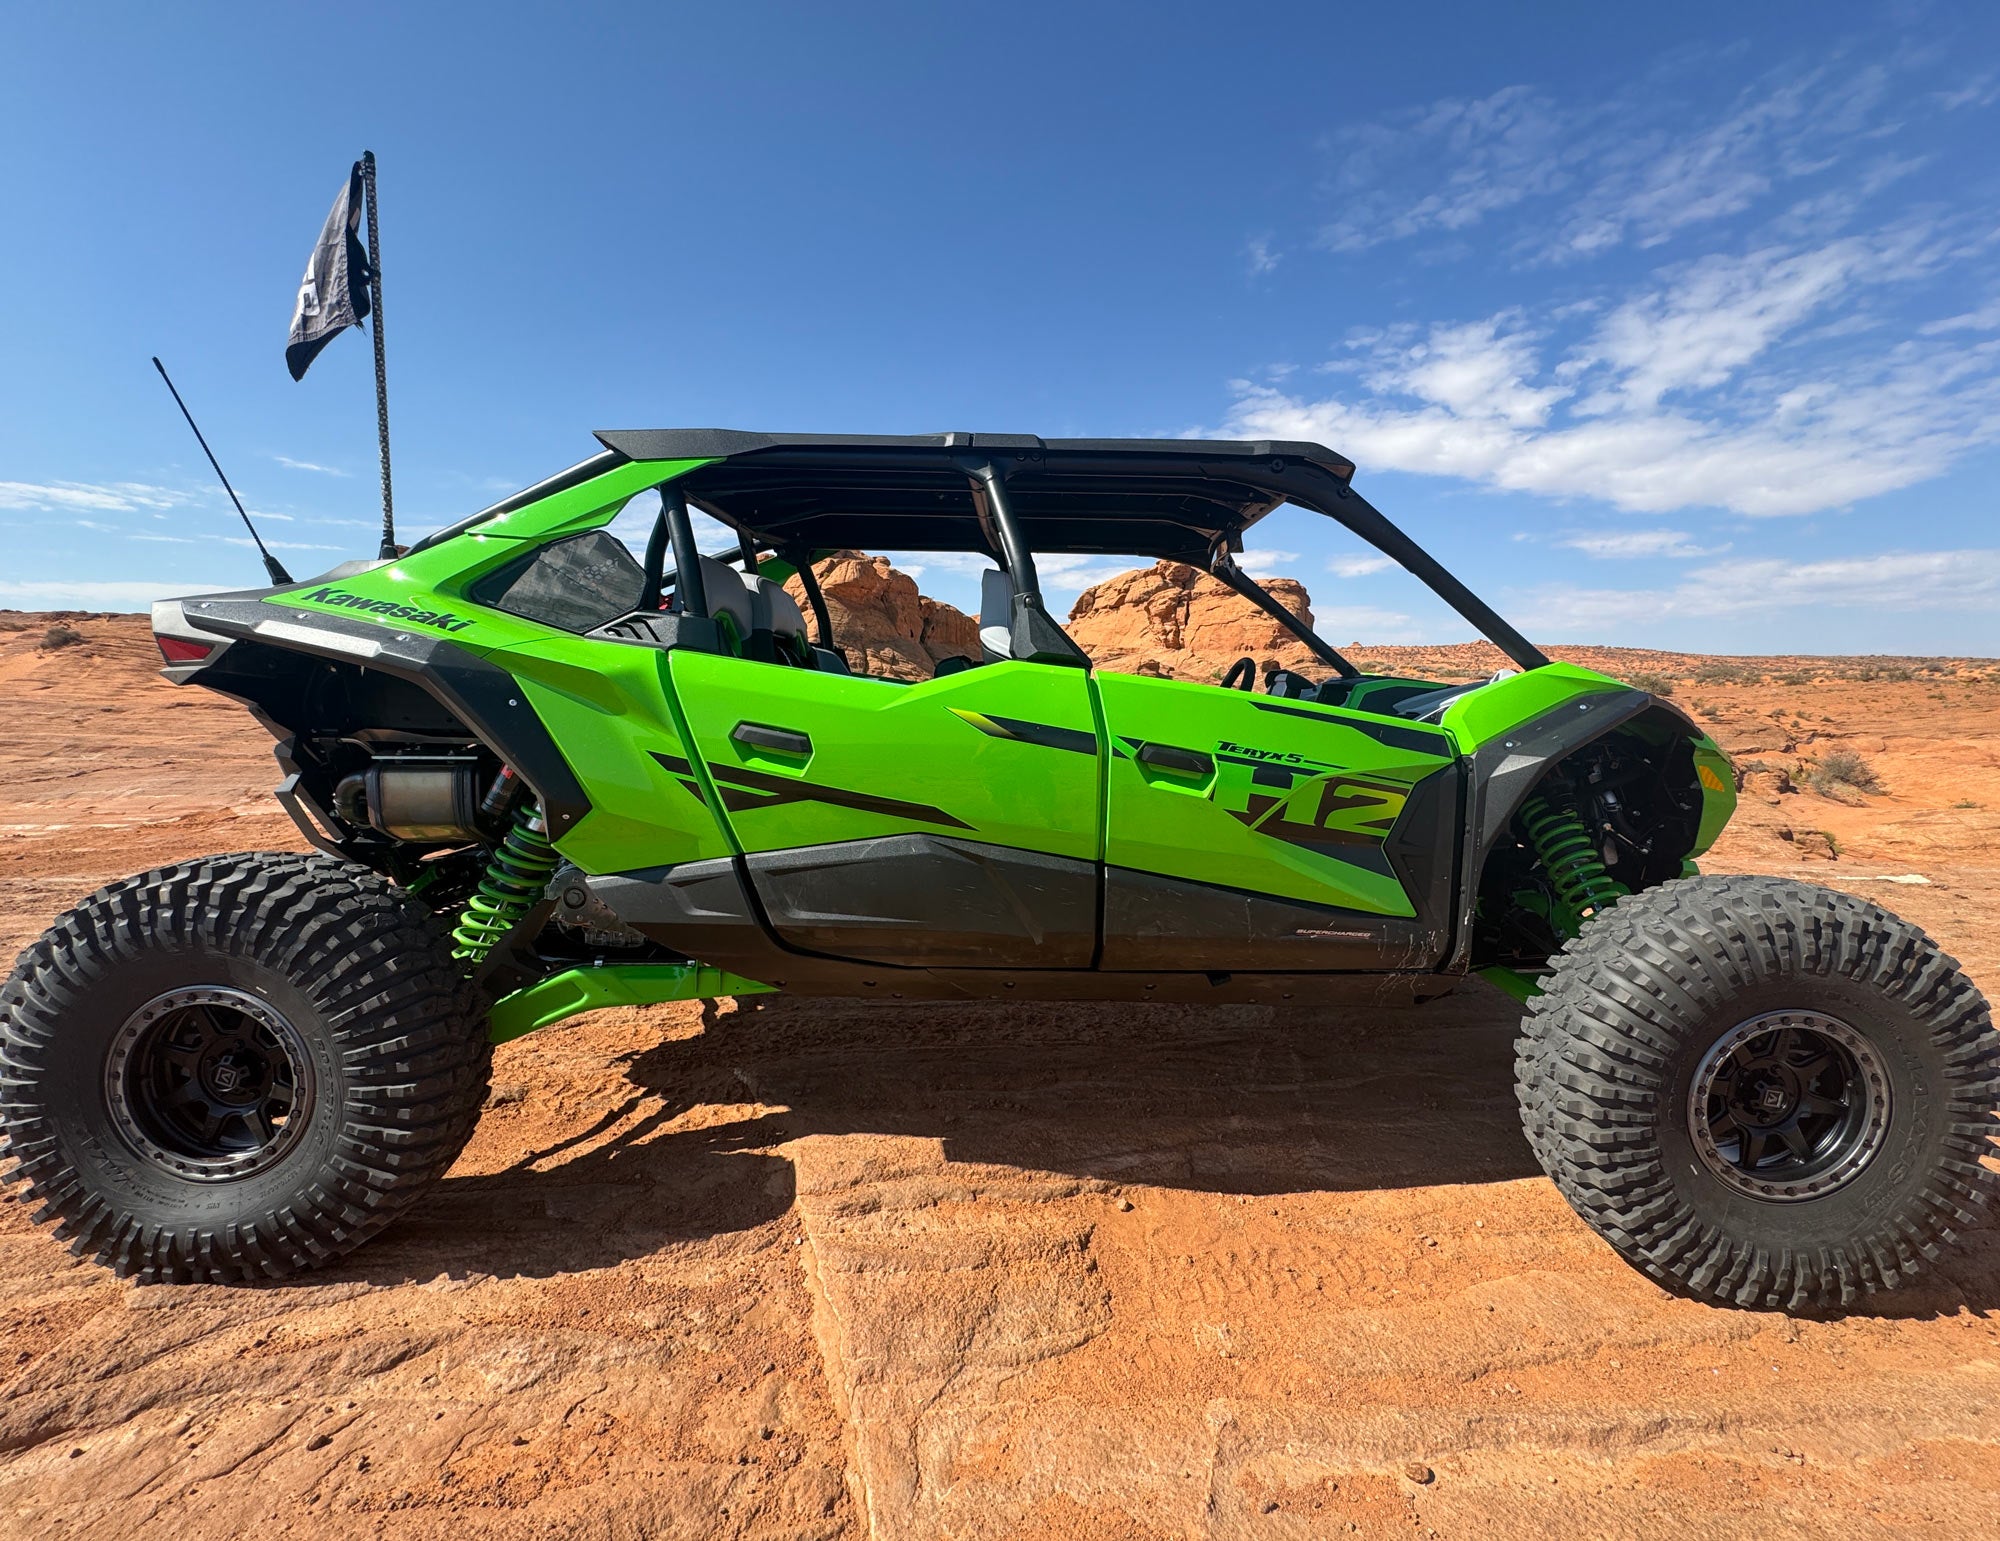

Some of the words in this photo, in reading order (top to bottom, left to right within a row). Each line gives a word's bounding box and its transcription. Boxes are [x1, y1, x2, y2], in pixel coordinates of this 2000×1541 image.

[302, 587, 477, 632] Kawasaki
[1213, 761, 1406, 837] H2
[1296, 928, 1371, 937] SUPERCHARGED
